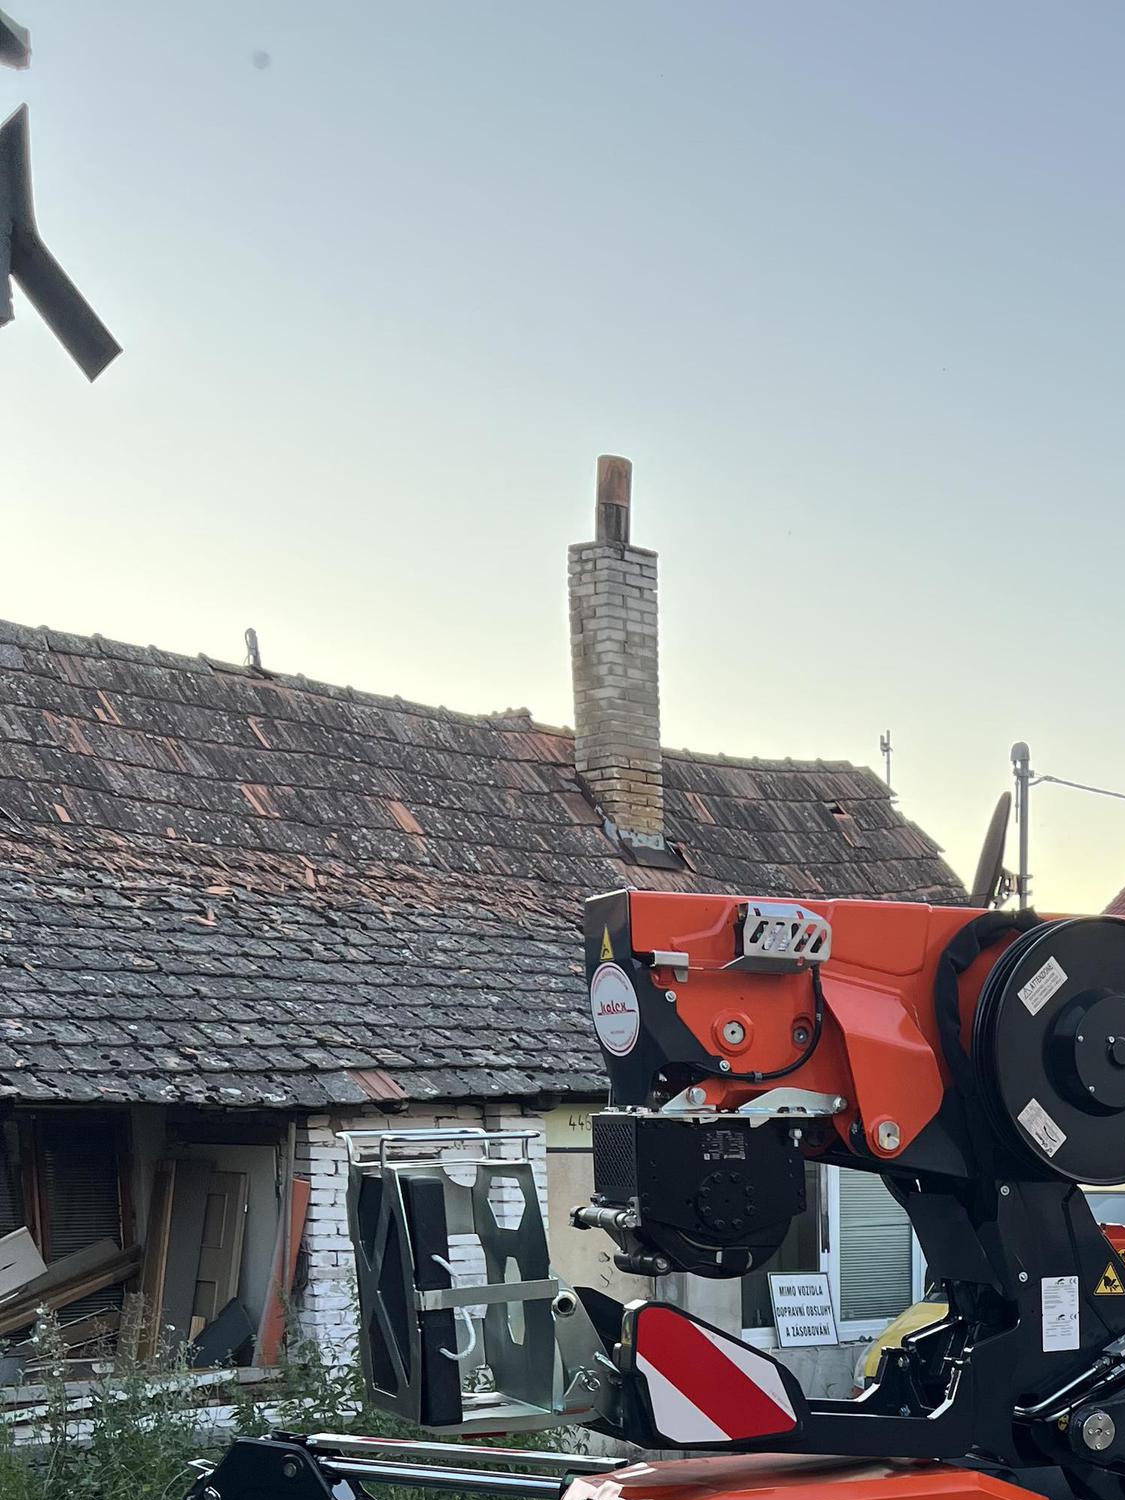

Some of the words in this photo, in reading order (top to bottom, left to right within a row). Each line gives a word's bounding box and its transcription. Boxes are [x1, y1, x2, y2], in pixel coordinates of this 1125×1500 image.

[779, 1286, 797, 1296] MIMO
[798, 1285, 823, 1296] VOZIDLA
[776, 1303, 805, 1317] DOPRAVNÍ
[806, 1305, 832, 1317] OBSLUHY
[786, 1327, 791, 1337] A
[791, 1323, 831, 1337] ZÁSOBOVÁNÍ
